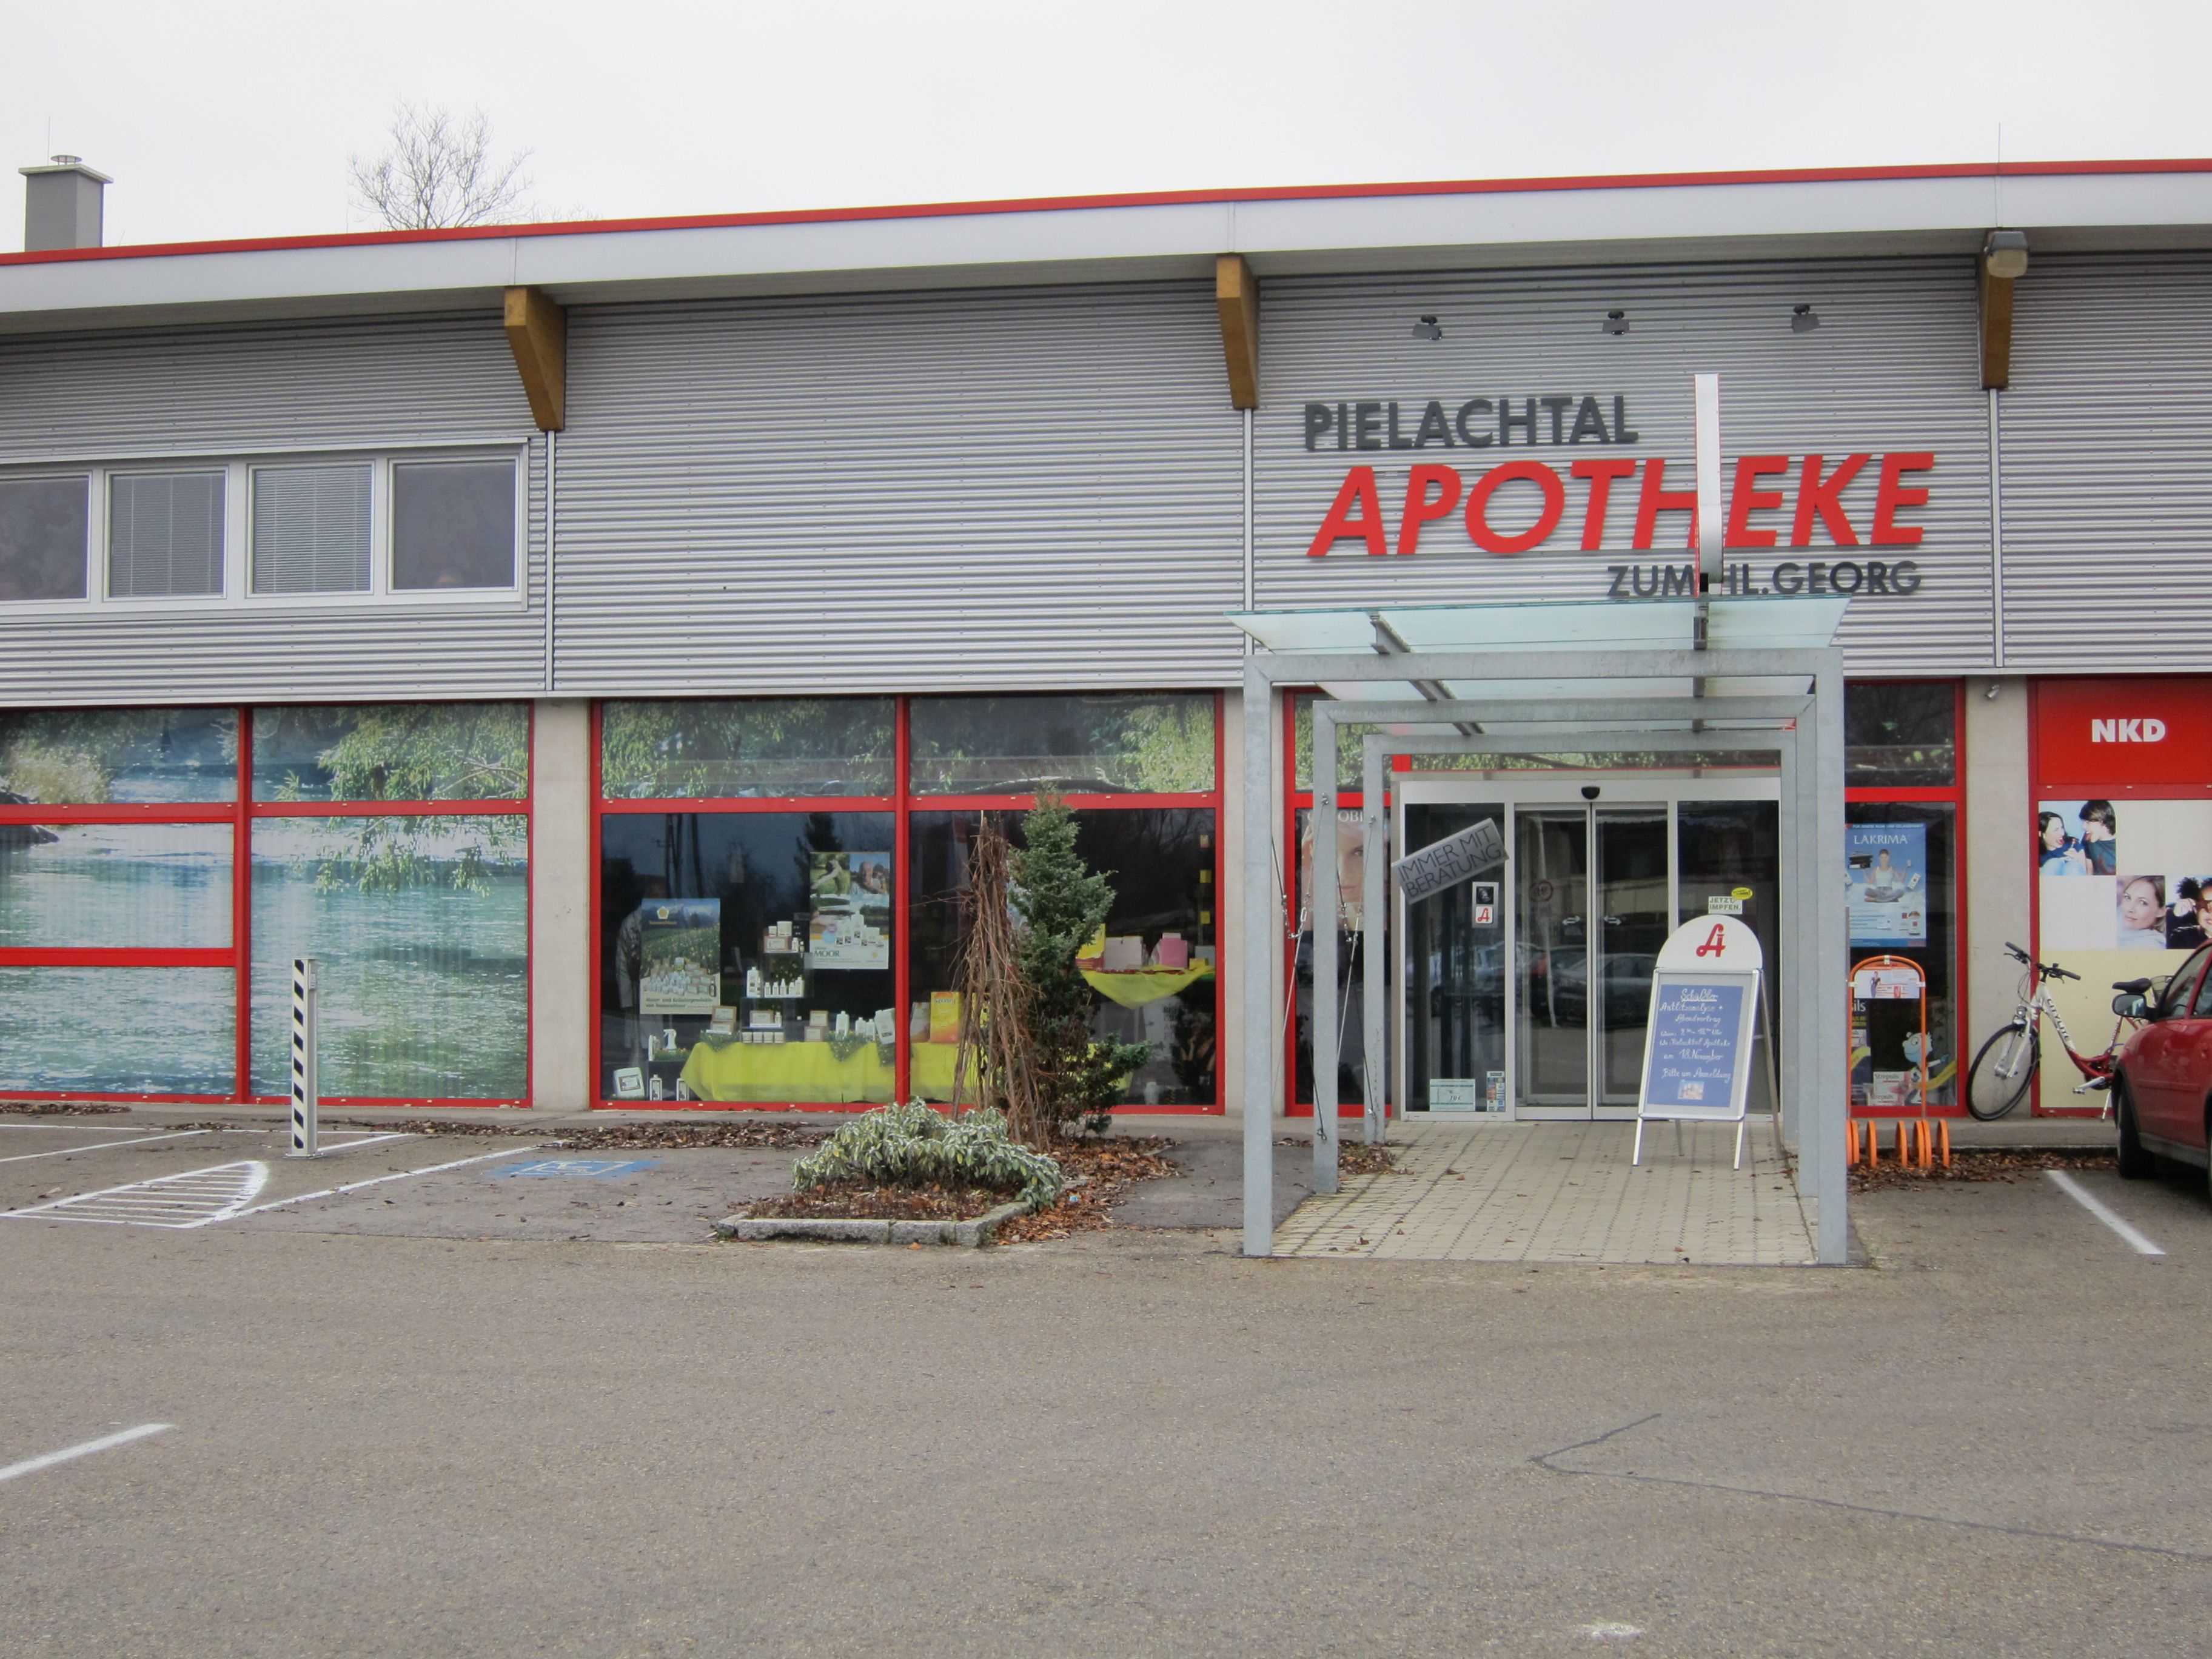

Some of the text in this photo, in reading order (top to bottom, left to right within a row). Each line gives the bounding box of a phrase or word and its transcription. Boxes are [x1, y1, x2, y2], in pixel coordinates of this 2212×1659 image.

[1305, 395, 1639, 451] PIELACHTAL
[1306, 452, 1934, 556] APOTHEKE
[1607, 565, 1695, 597] ZUM
[2091, 719, 2166, 743] NKD
[1398, 826, 1489, 881] IMMER MIT
[1854, 835, 1908, 844] LAKRIMA
[1406, 843, 1501, 897] BERATUNG
[1661, 1068, 1679, 1078] Bitte
[1694, 1067, 1731, 1083] Anmeldung
